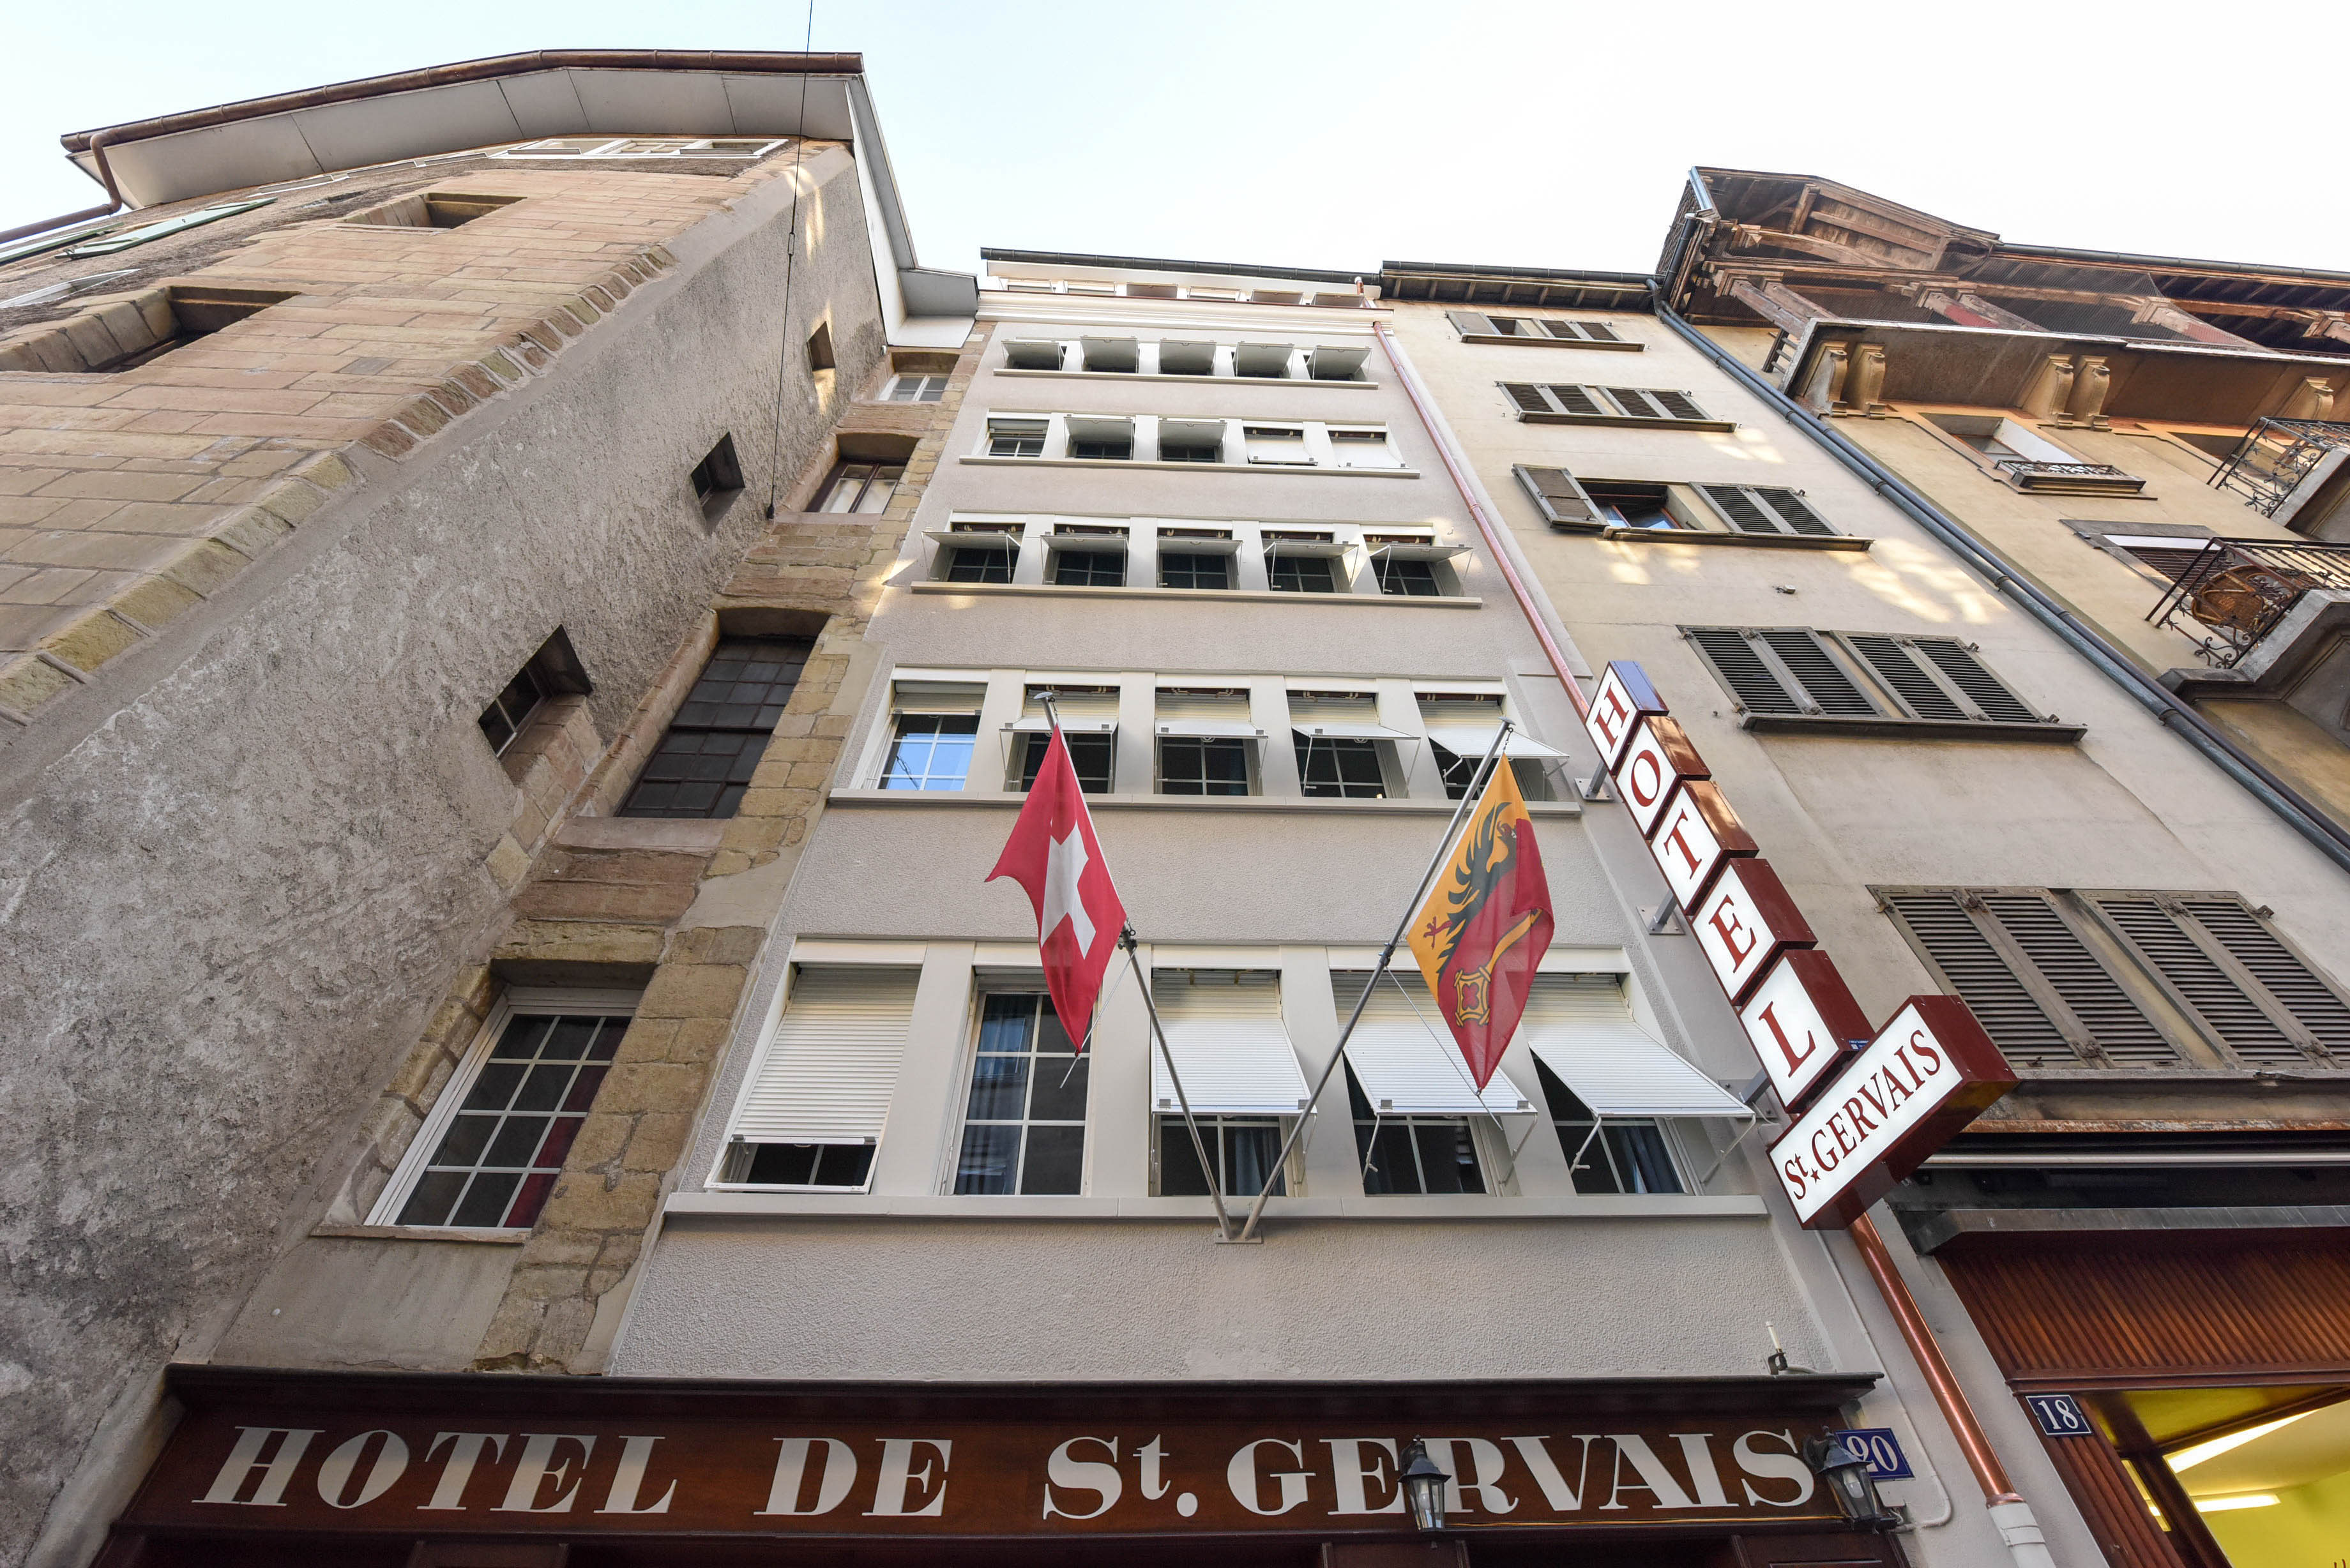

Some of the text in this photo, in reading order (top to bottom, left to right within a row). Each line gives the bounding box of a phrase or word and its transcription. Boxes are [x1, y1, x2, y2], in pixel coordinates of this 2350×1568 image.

[1594, 687, 1817, 1078] HOTEL
[2038, 1399, 2079, 1429] 18
[192, 1426, 1814, 1519] HOTEL DE St. GERVAIS
[1846, 1435, 1899, 1472] 20
